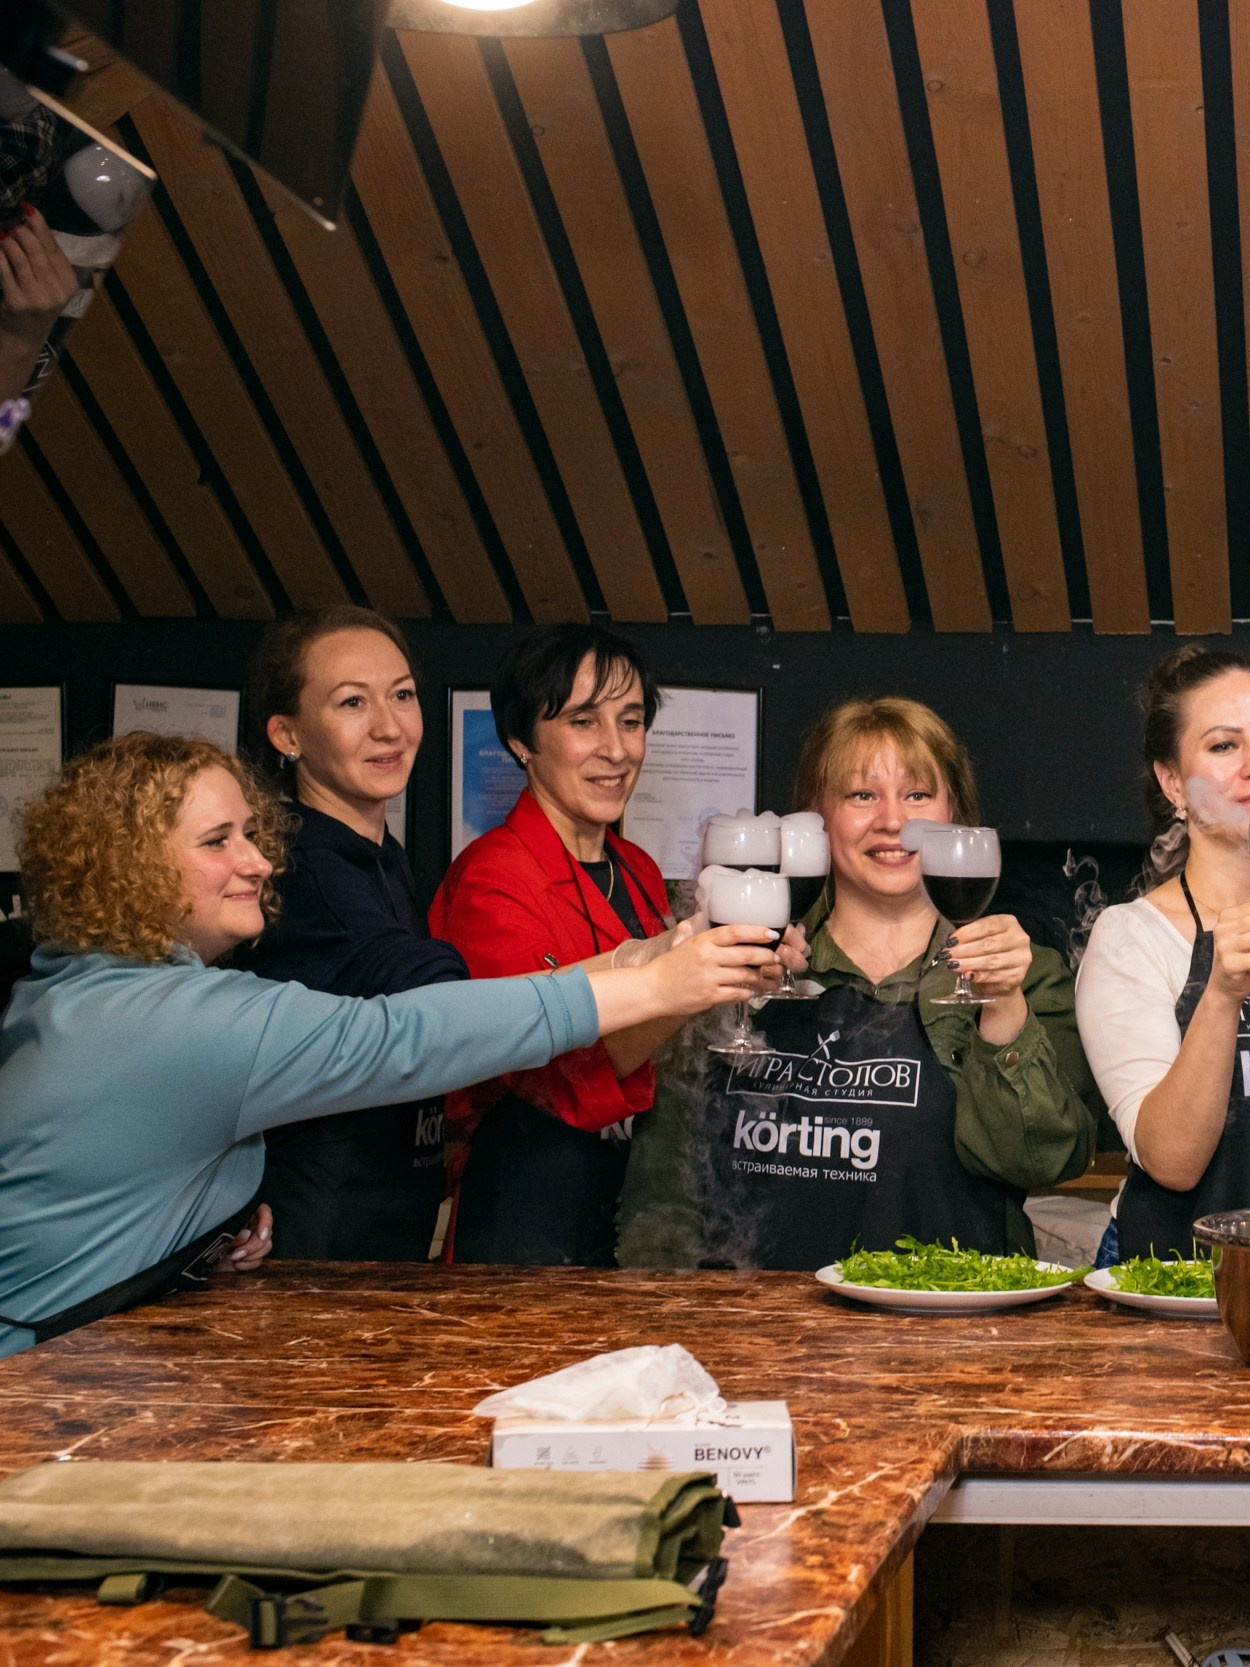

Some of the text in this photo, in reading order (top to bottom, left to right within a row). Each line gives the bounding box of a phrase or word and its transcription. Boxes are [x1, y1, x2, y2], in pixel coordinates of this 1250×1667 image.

[735, 1054, 911, 1089] ИГРА СТОЛОВ
[824, 1088, 874, 1097] СТУДИЯ
[823, 1115, 874, 1127] since 1889
[732, 1109, 881, 1170] körting
[731, 1159, 877, 1183] встраиваемая техника
